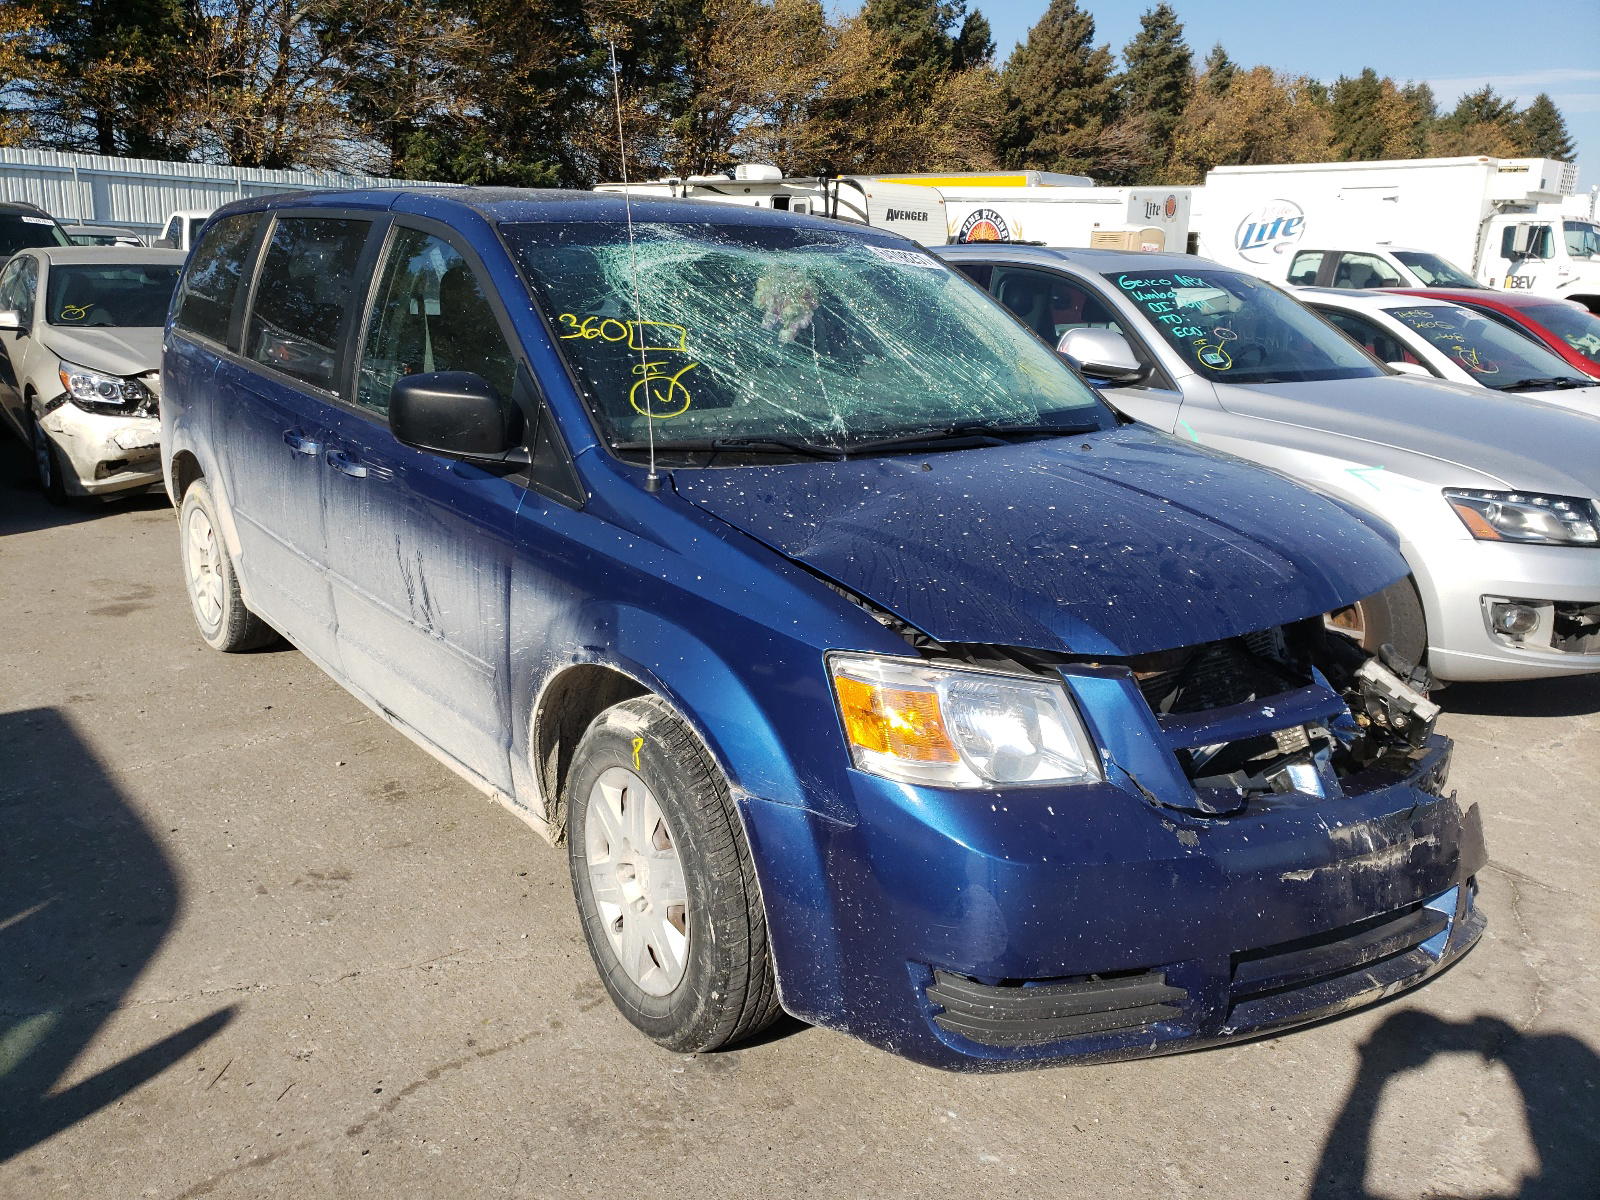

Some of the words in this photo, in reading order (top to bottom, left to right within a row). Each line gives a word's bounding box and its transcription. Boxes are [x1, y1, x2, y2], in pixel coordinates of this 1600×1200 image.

[886, 208, 929, 222] AVENGER
[1145, 201, 1161, 219] Lite
[962, 211, 981, 234] FINE
[1239, 216, 1304, 250] Lite
[558, 313, 628, 342] 360
